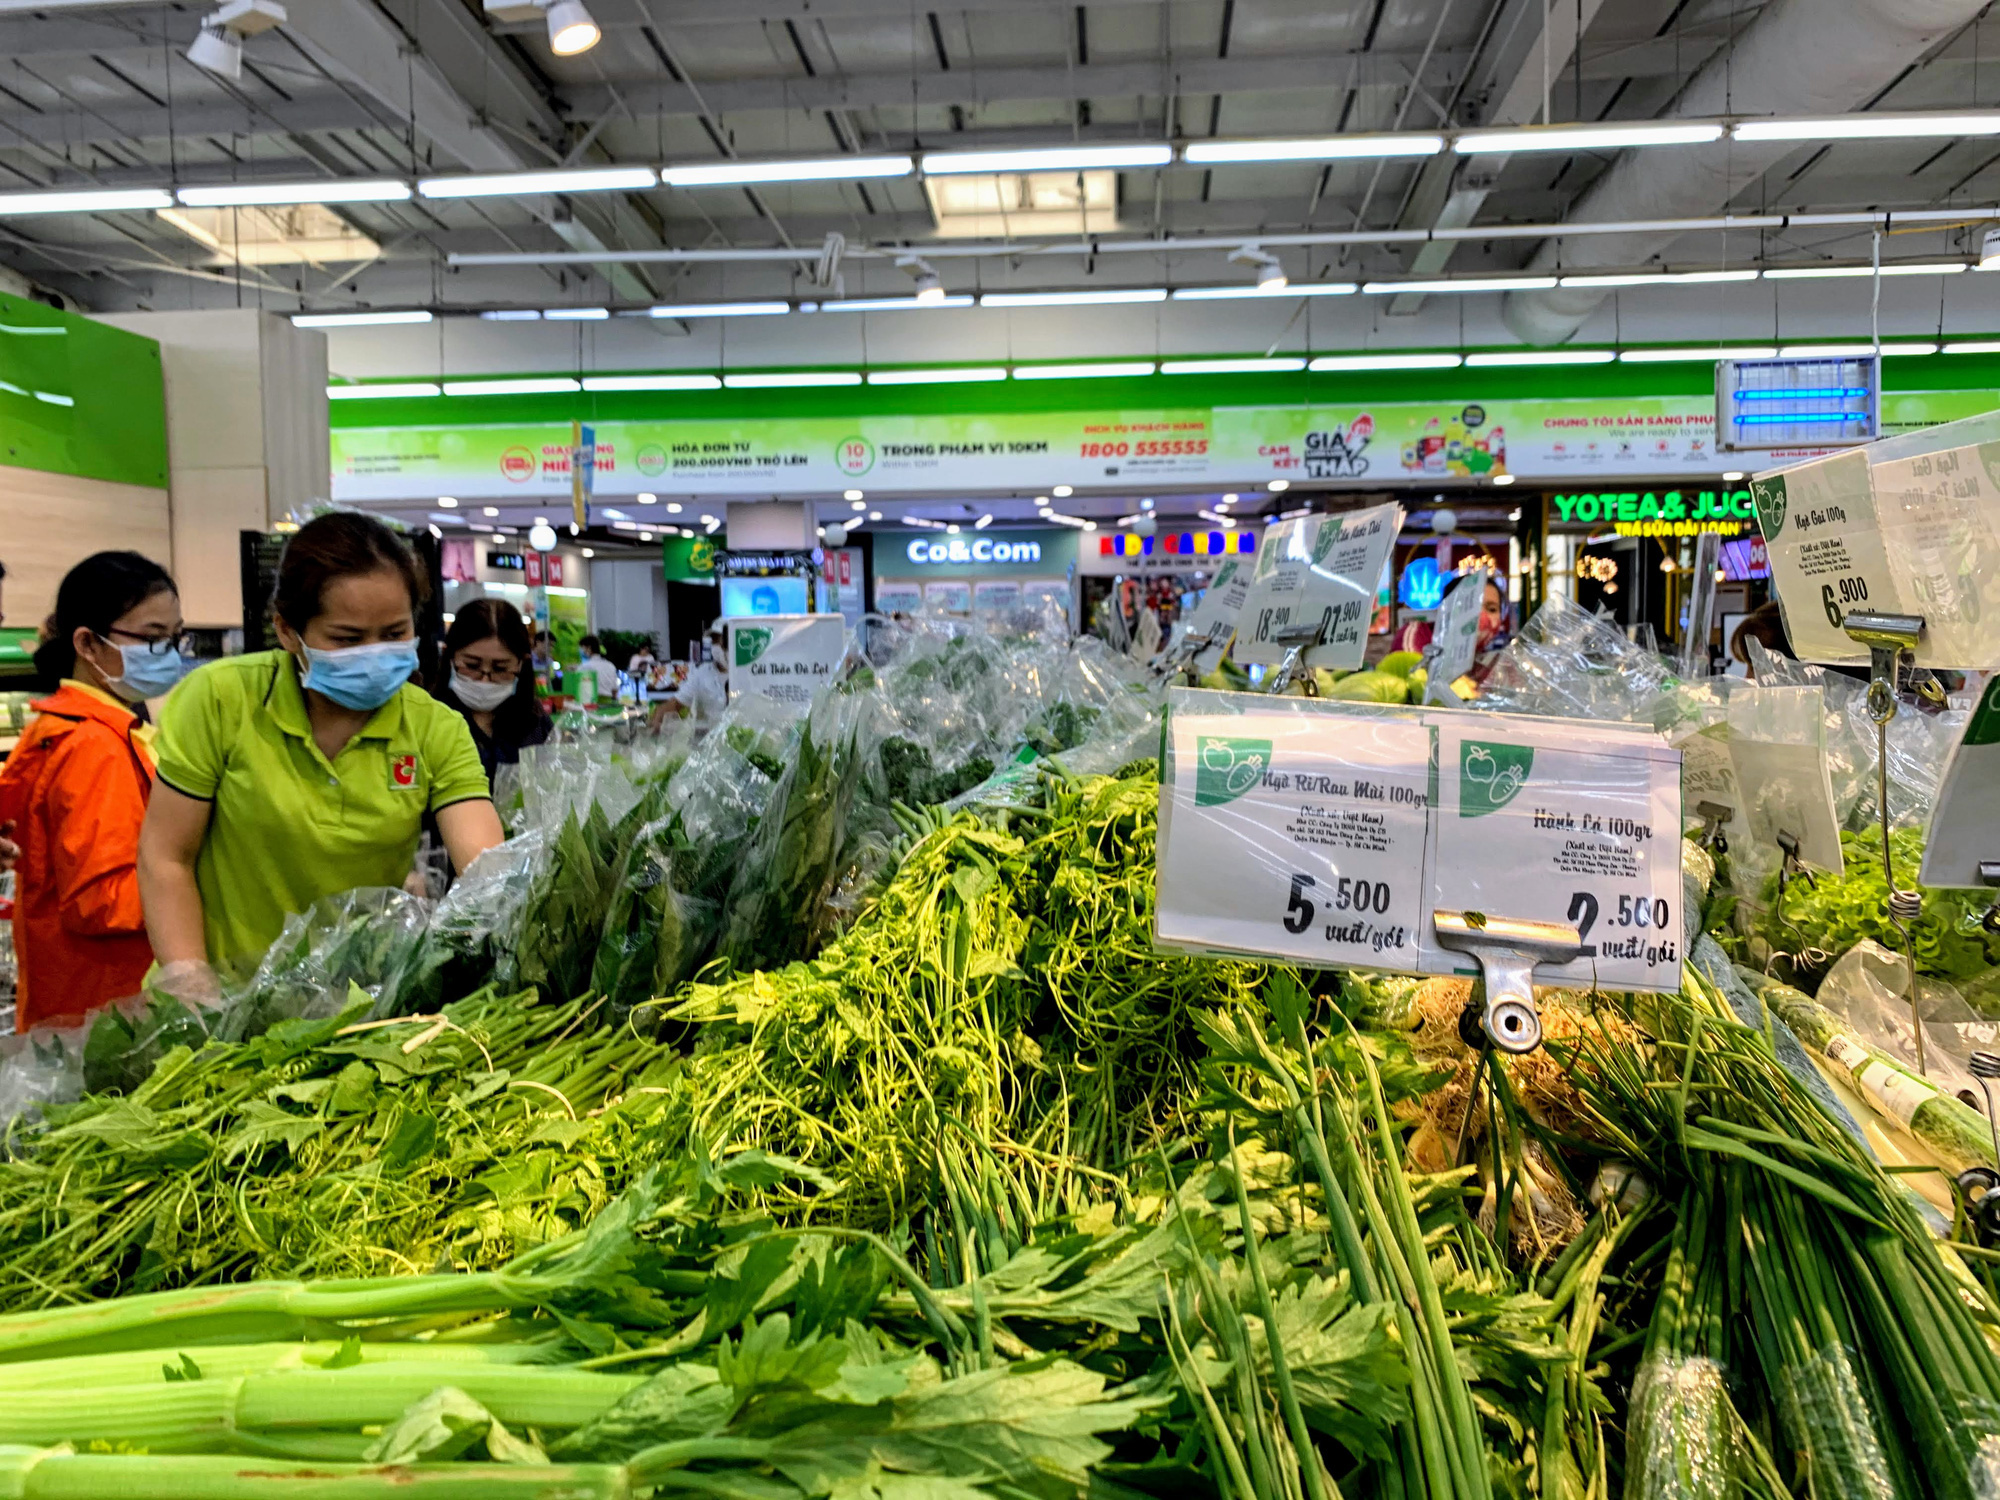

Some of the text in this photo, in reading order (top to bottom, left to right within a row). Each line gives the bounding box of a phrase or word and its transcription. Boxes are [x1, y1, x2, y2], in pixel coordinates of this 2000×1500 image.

[847, 444, 864, 457] 10
[881, 443, 935, 457] TRONG
[988, 442, 1004, 455] VI
[1008, 441, 1048, 454] 10KM
[1081, 439, 1209, 458] 1800 555555
[1826, 506, 1847, 524] 100g
[906, 537, 1042, 563] Co&Com
[1750, 545, 1765, 563] 06
[1608, 817, 1653, 842] 100gr
